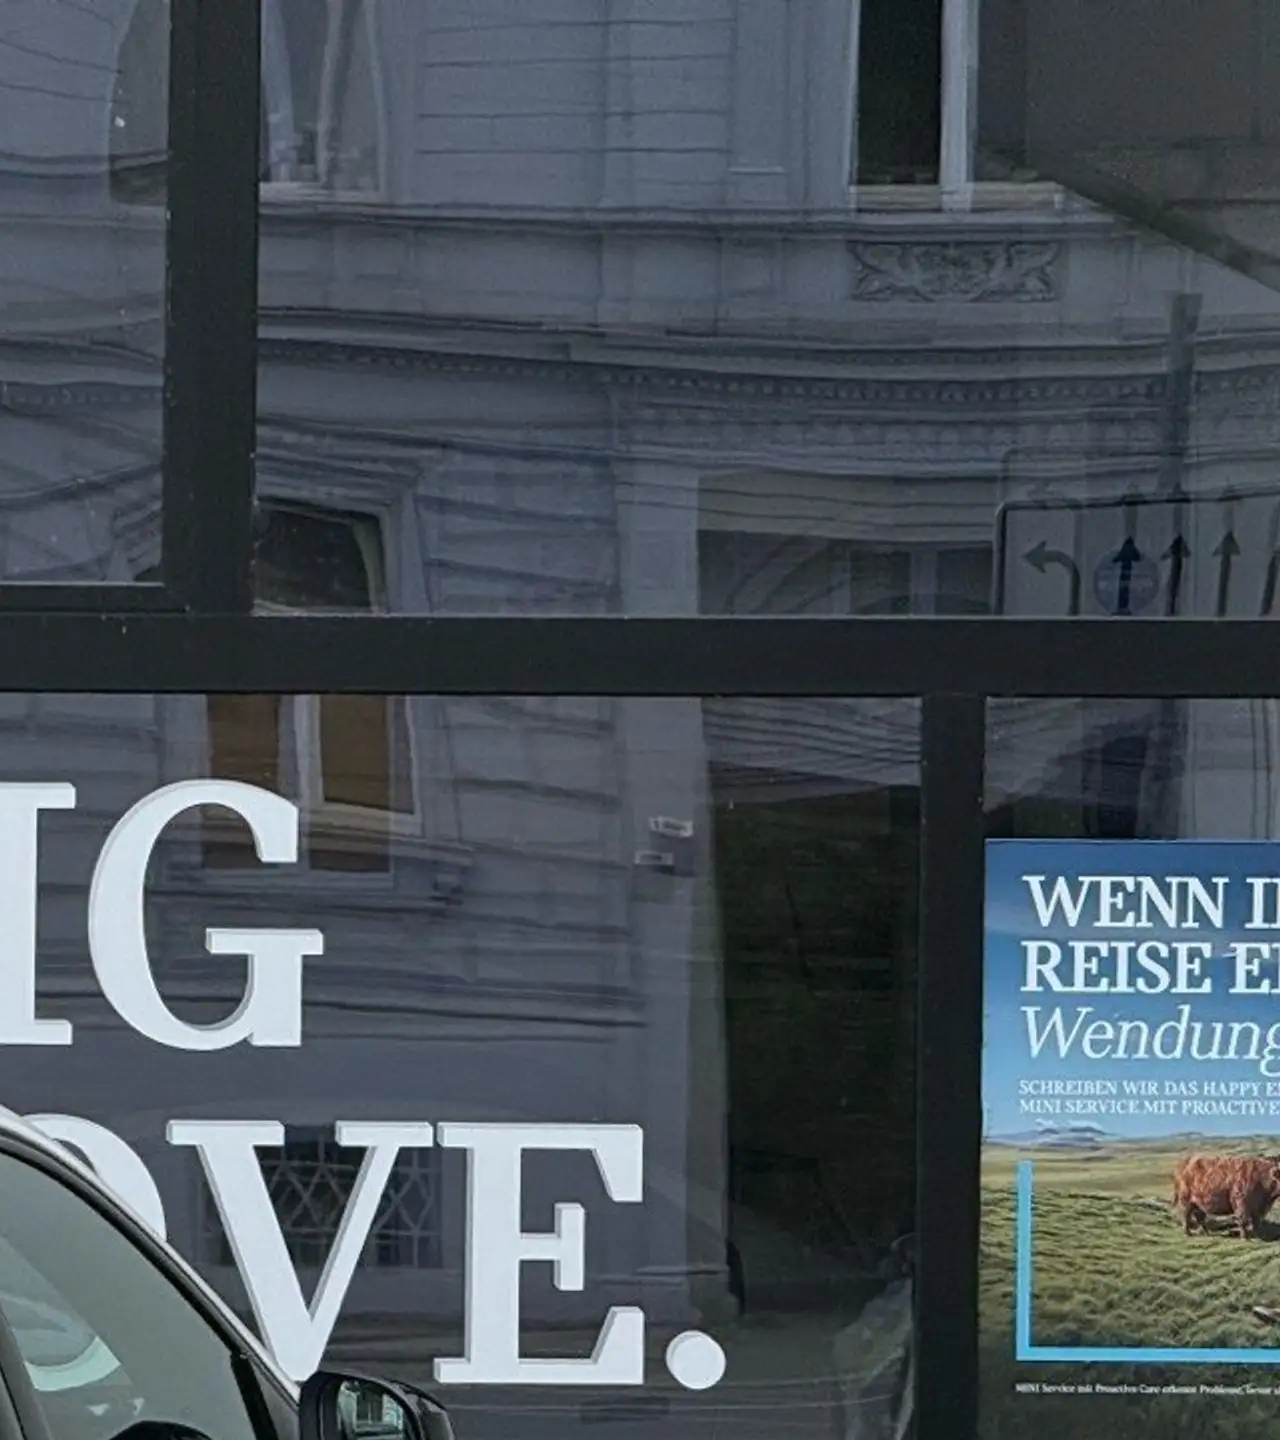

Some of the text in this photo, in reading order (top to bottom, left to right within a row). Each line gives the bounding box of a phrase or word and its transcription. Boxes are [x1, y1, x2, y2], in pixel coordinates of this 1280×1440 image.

[1021, 875, 1229, 929] WENN
[1020, 940, 1213, 994] REISE
[1018, 1080, 1117, 1096] SCHREIBEN
[1123, 1080, 1159, 1096] WIR
[1164, 1080, 1198, 1096] DAS
[1204, 1080, 1264, 1097] HAPPY
[1019, 1099, 1280, 1115] MINI SERVICE MIT PROACTIVE
